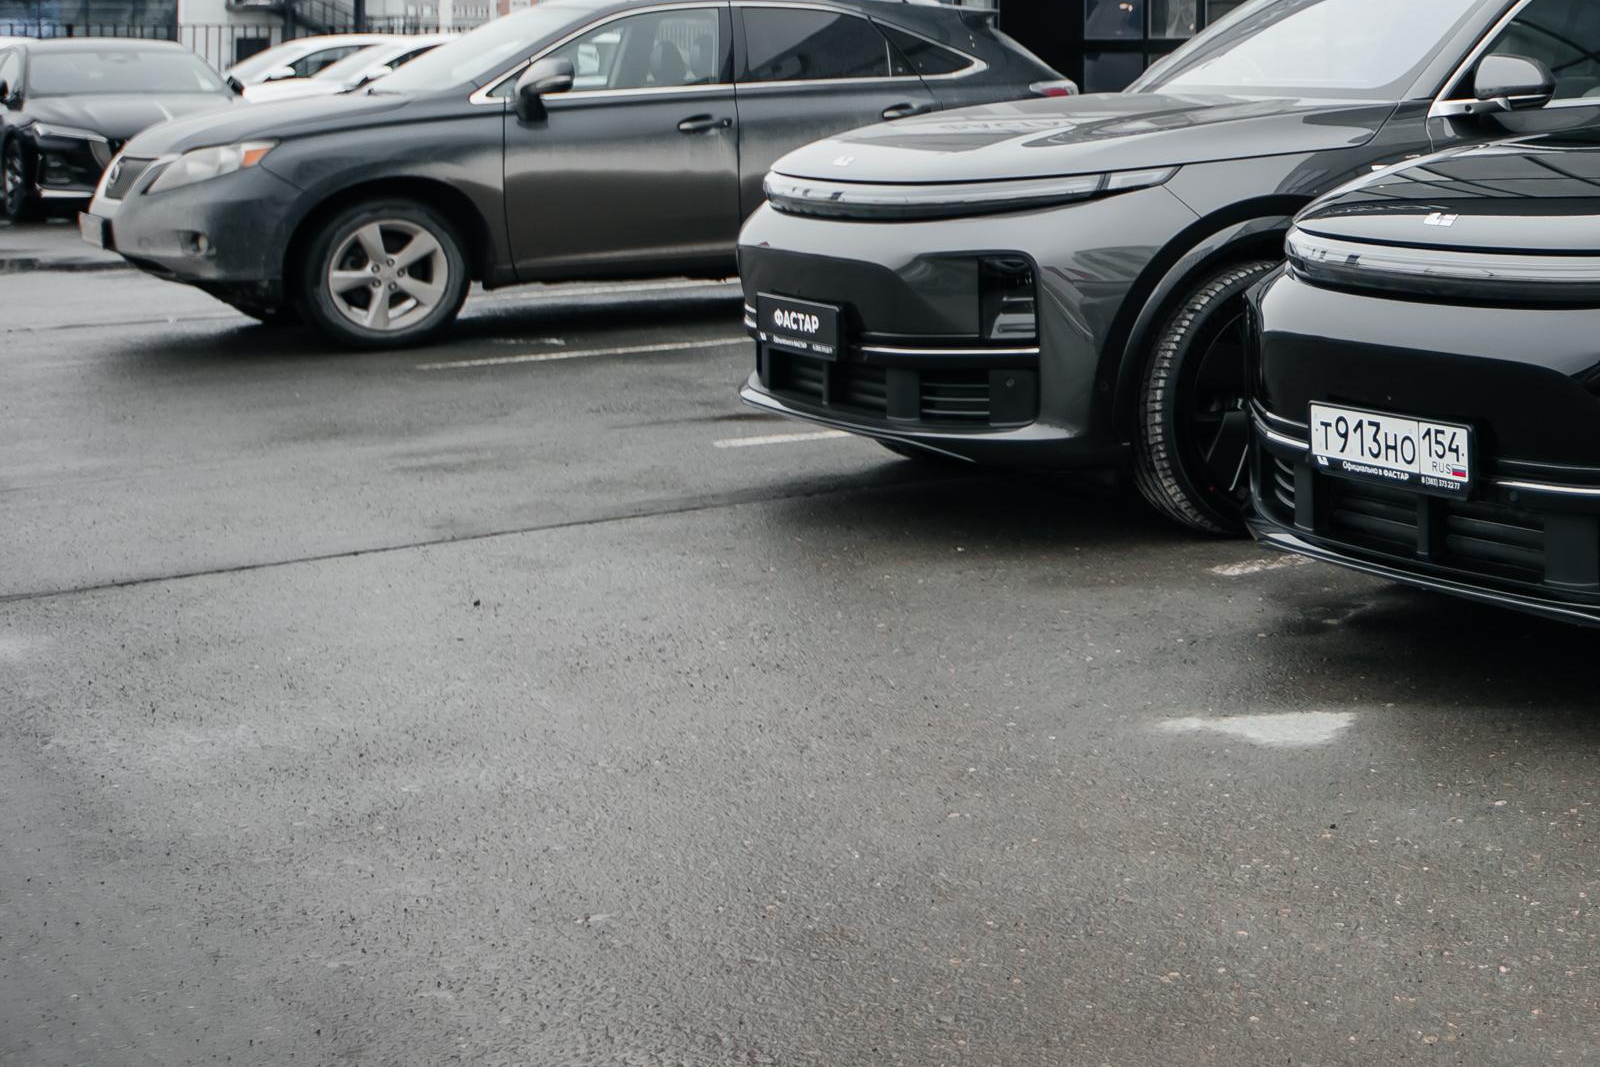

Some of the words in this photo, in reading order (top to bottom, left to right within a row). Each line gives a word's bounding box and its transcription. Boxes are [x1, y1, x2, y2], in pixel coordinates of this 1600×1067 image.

[774, 308, 820, 334] ФАСТАР
[1421, 427, 1460, 463] 154
[1383, 469, 1410, 481] ФАСТАР
[1431, 460, 1451, 475] RUS
